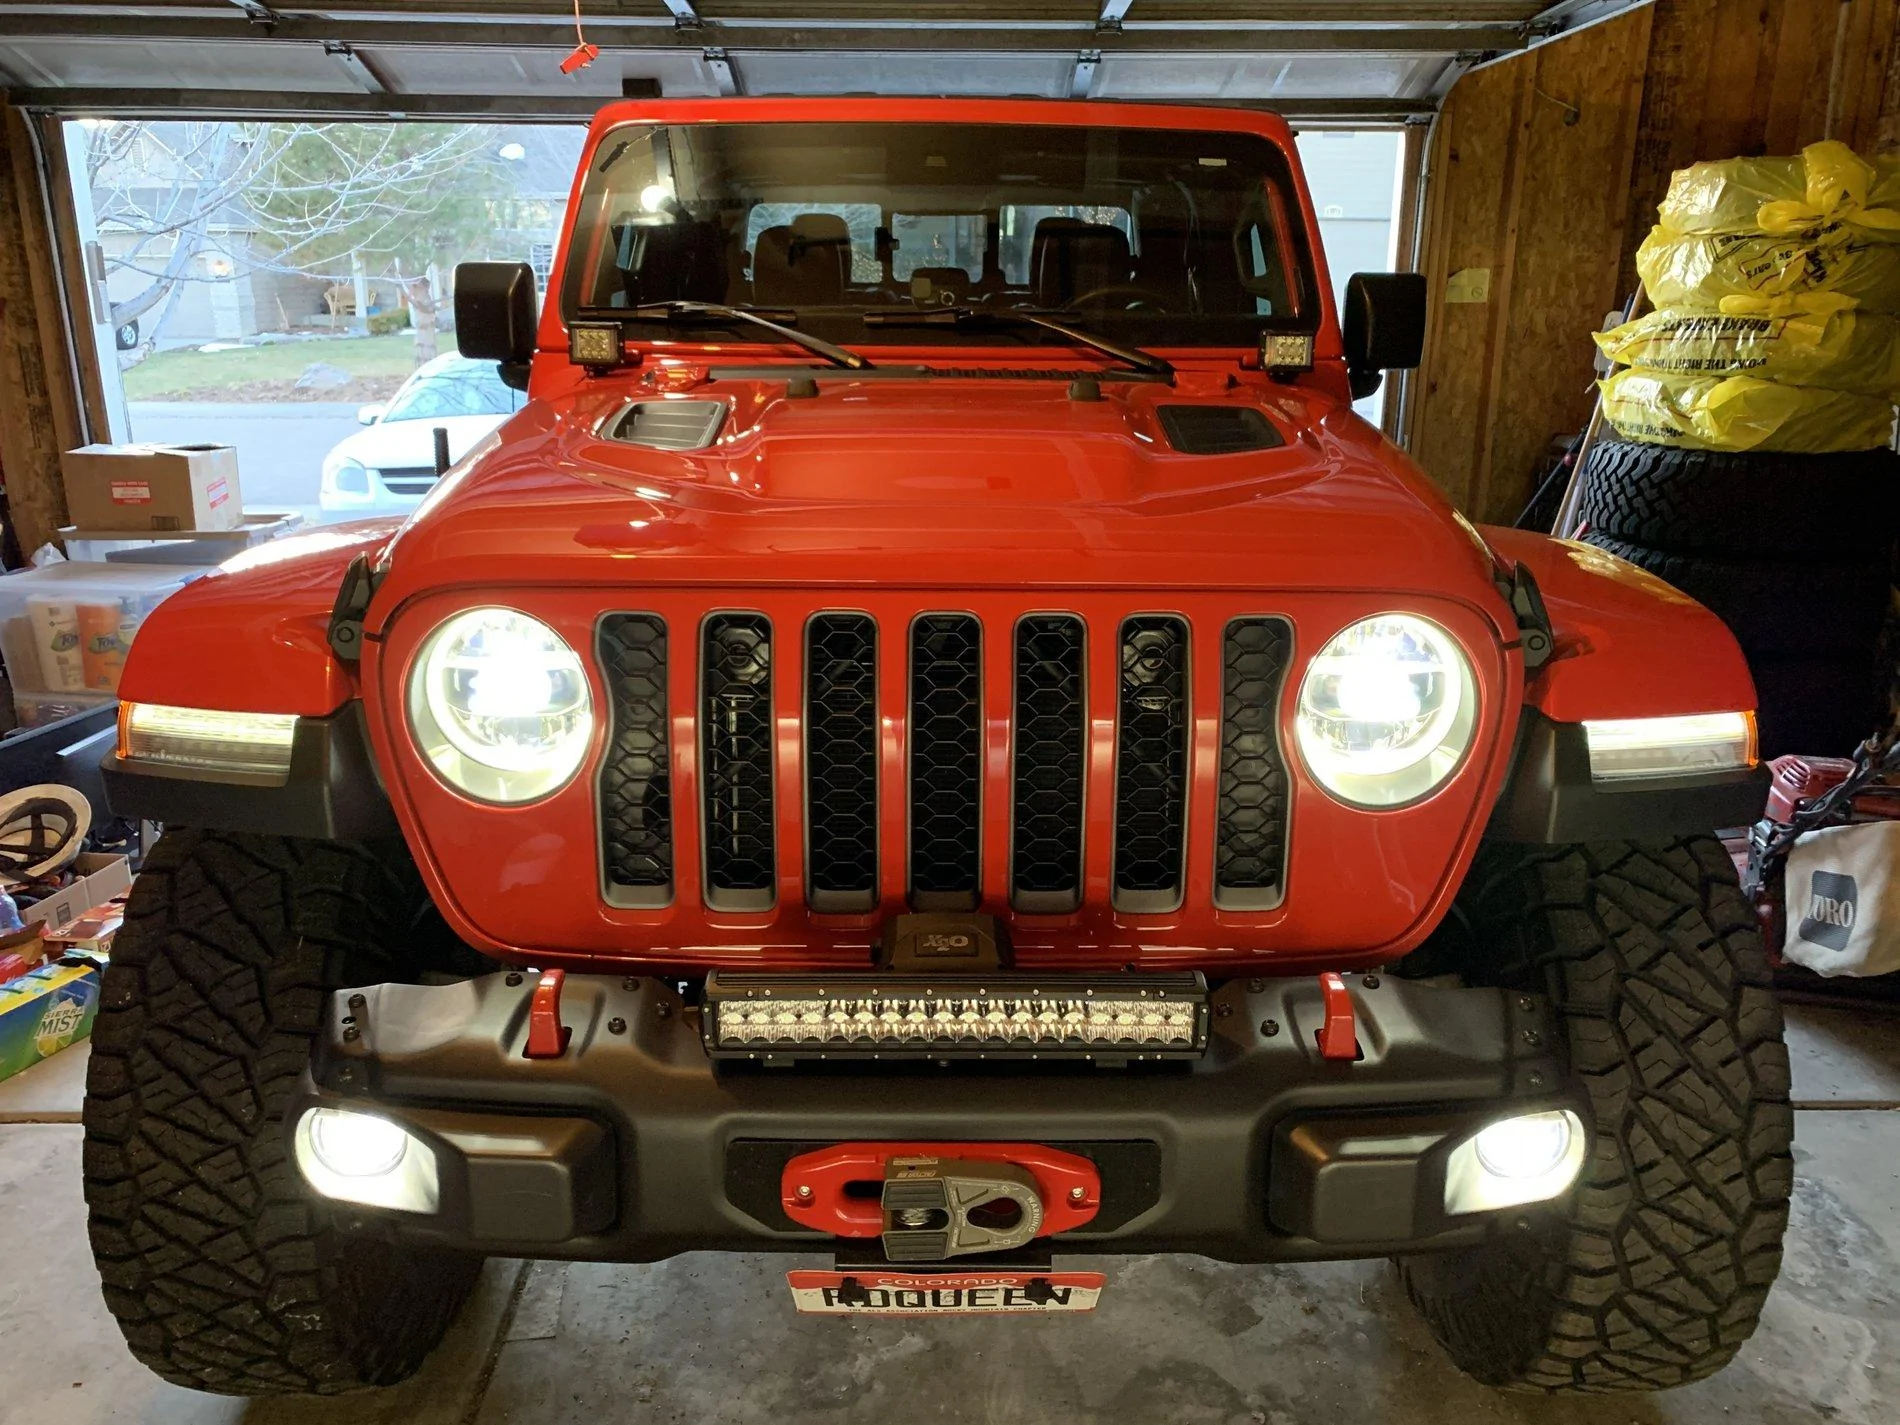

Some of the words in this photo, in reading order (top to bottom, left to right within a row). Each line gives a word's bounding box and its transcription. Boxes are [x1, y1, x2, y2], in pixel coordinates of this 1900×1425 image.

[1704, 358, 1726, 370] THE
[38, 1014, 83, 1035] MIST
[1027, 1196, 1040, 1233] WARNING
[877, 1278, 1018, 1286] COLORADO
